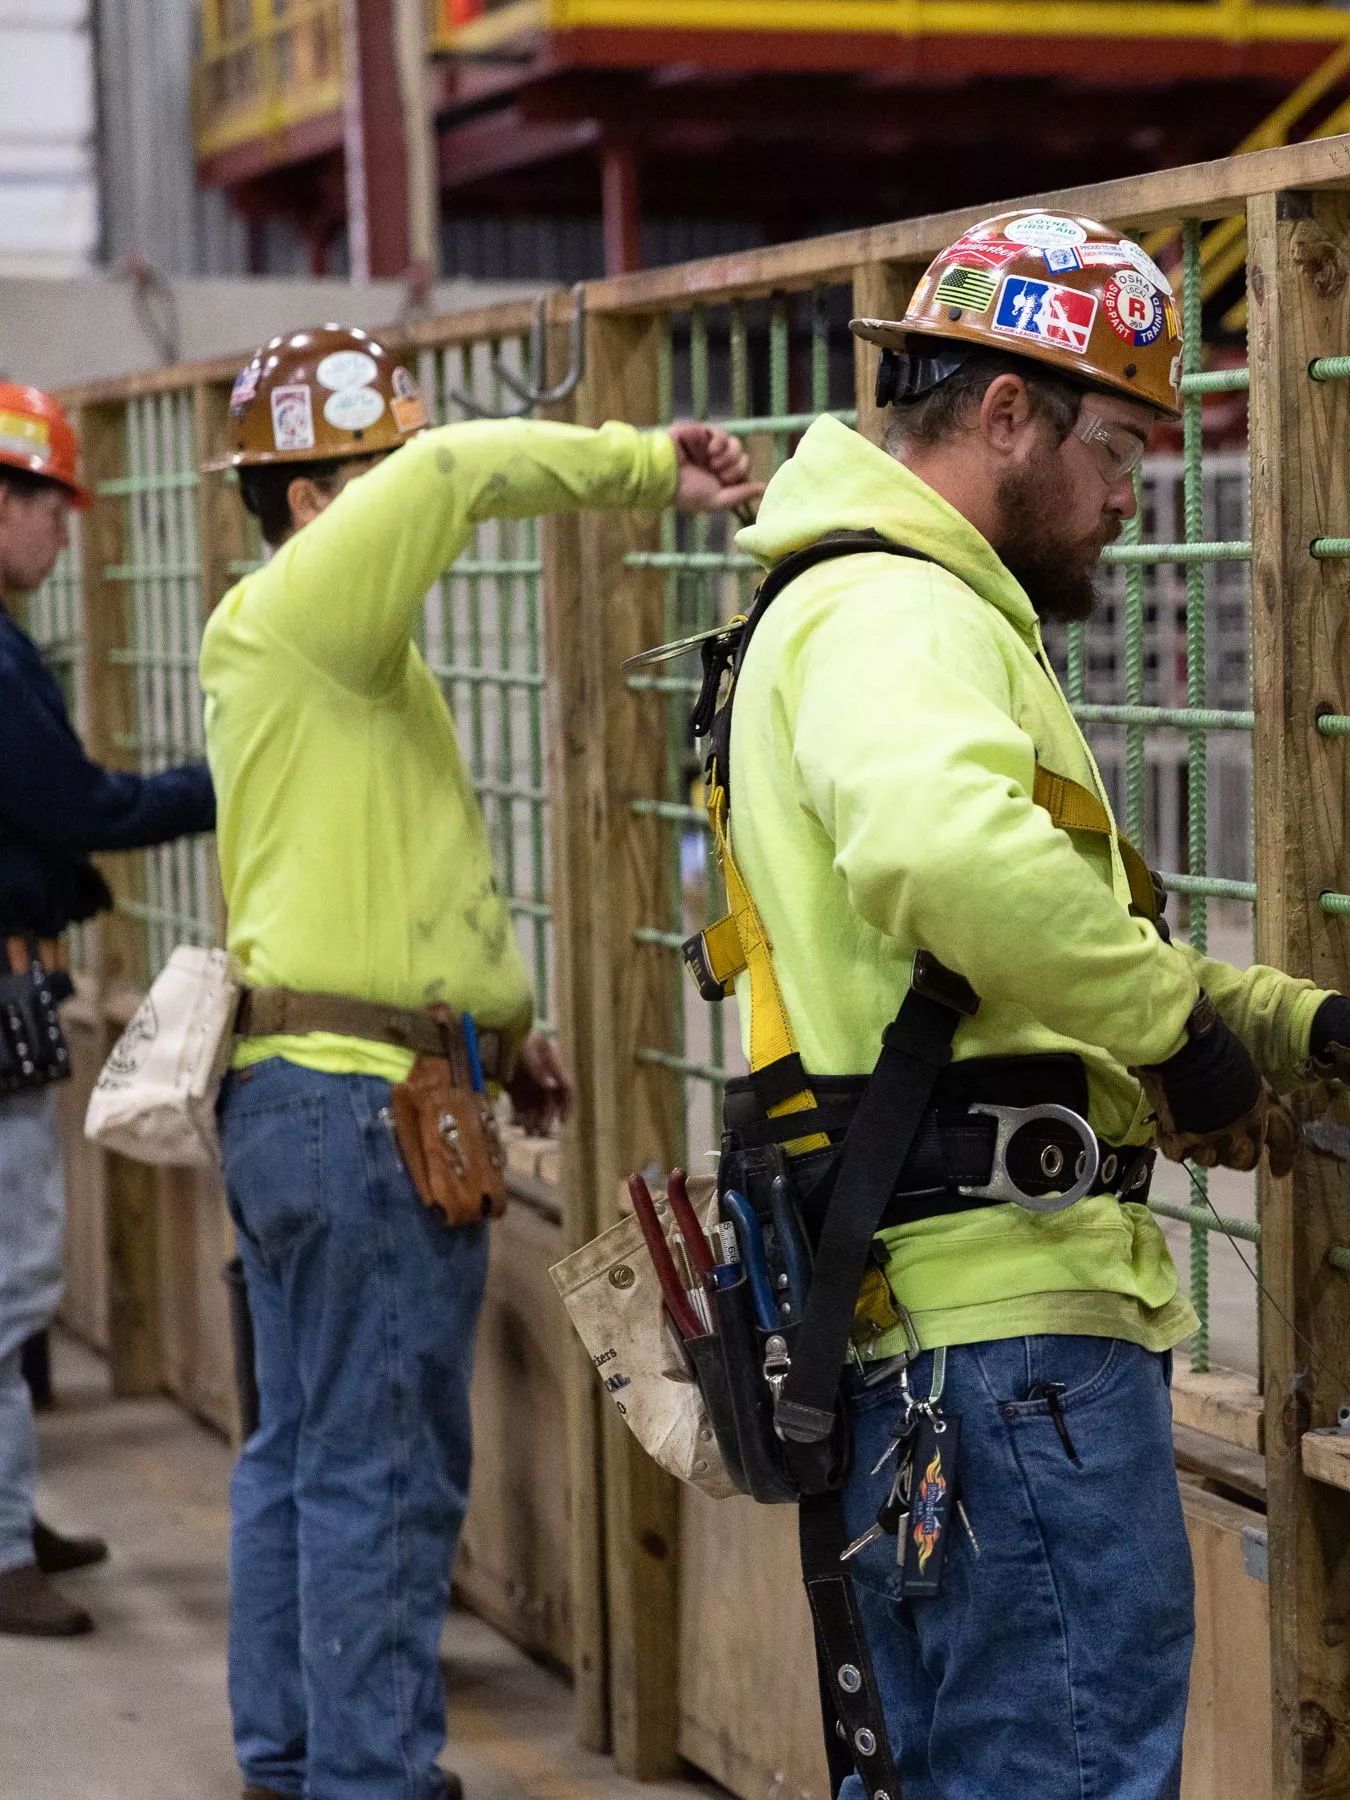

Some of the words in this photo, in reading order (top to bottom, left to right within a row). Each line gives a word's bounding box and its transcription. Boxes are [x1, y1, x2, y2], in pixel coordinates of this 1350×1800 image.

[1028, 219, 1068, 227] COYNE
[1055, 227, 1077, 235] AID
[1119, 274, 1150, 292] OSHA
[1126, 287, 1146, 298] LOCAL
[1105, 284, 1131, 338] SUB-PART
[1140, 297, 1162, 343] TRAINED
[1128, 297, 1145, 321] R
[994, 326, 1015, 334] MAJOR
[1015, 330, 1039, 339] LEAGUE
